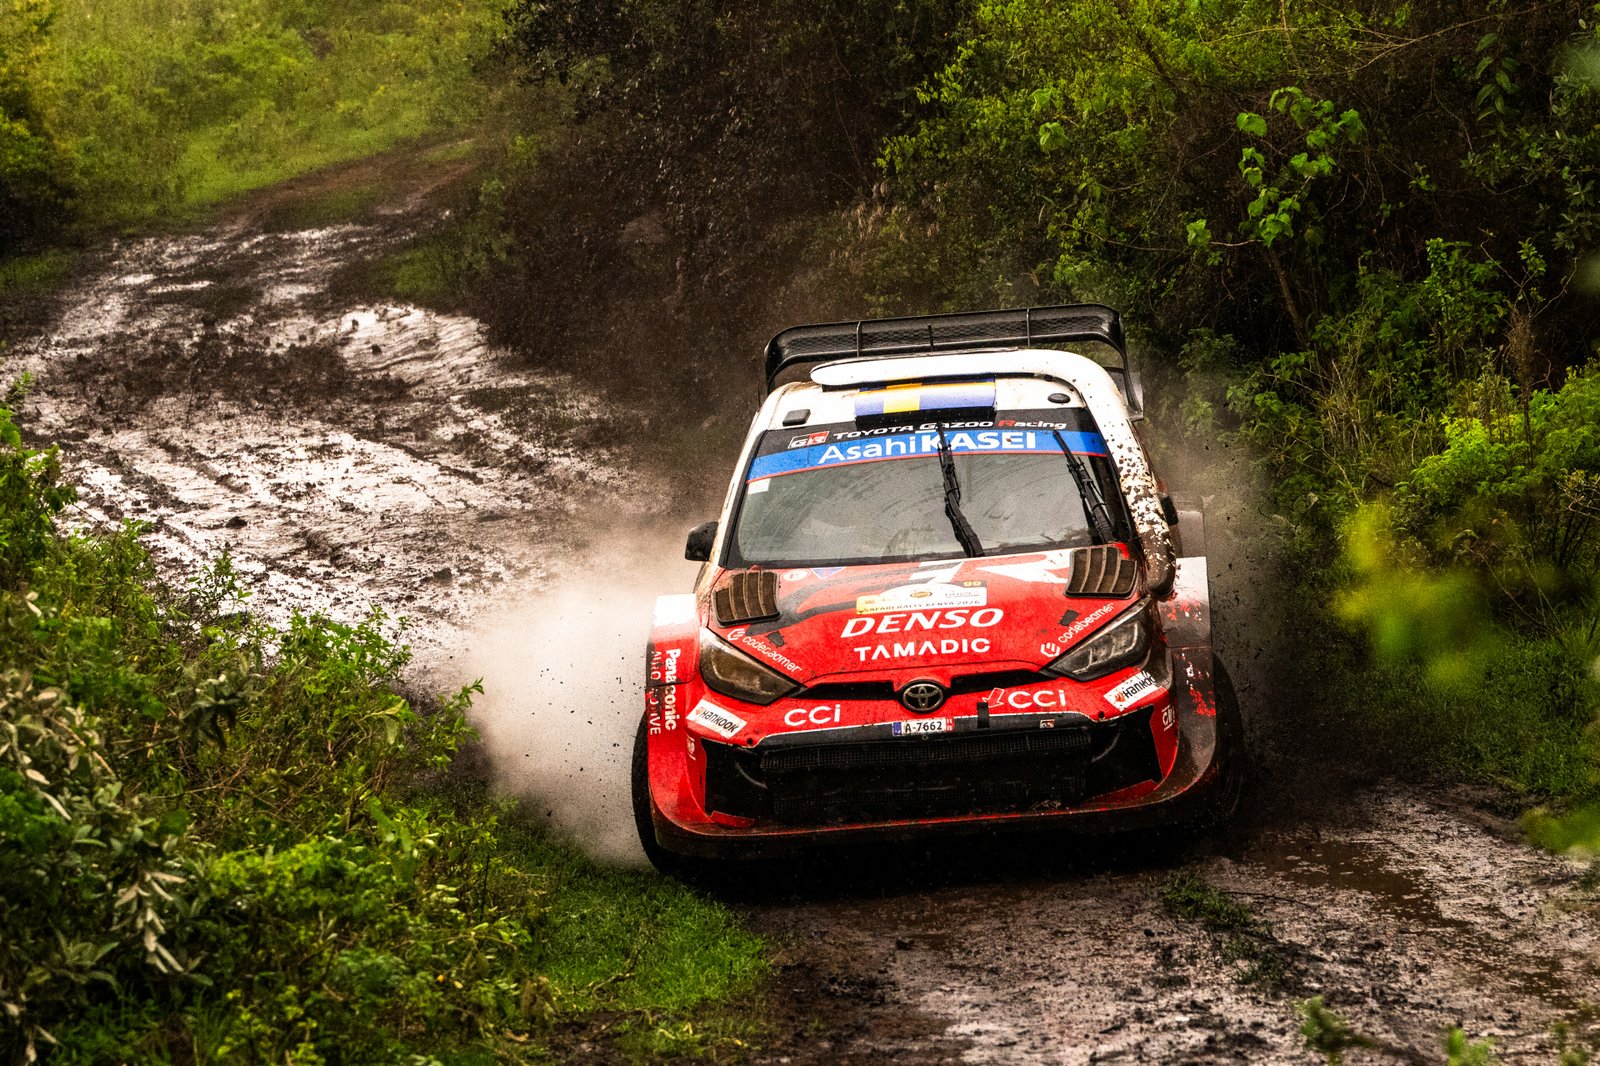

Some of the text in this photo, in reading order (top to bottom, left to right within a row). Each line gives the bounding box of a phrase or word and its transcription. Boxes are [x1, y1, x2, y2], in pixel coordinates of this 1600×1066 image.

[833, 425, 914, 440] TOYOTA
[998, 419, 1067, 430] Racing
[818, 431, 1036, 464] Asahi KASEI
[840, 608, 1005, 638] DENSO
[853, 638, 990, 661] TAMADIC
[664, 648, 681, 731] Panasonic
[904, 721, 943, 733] A-7662
